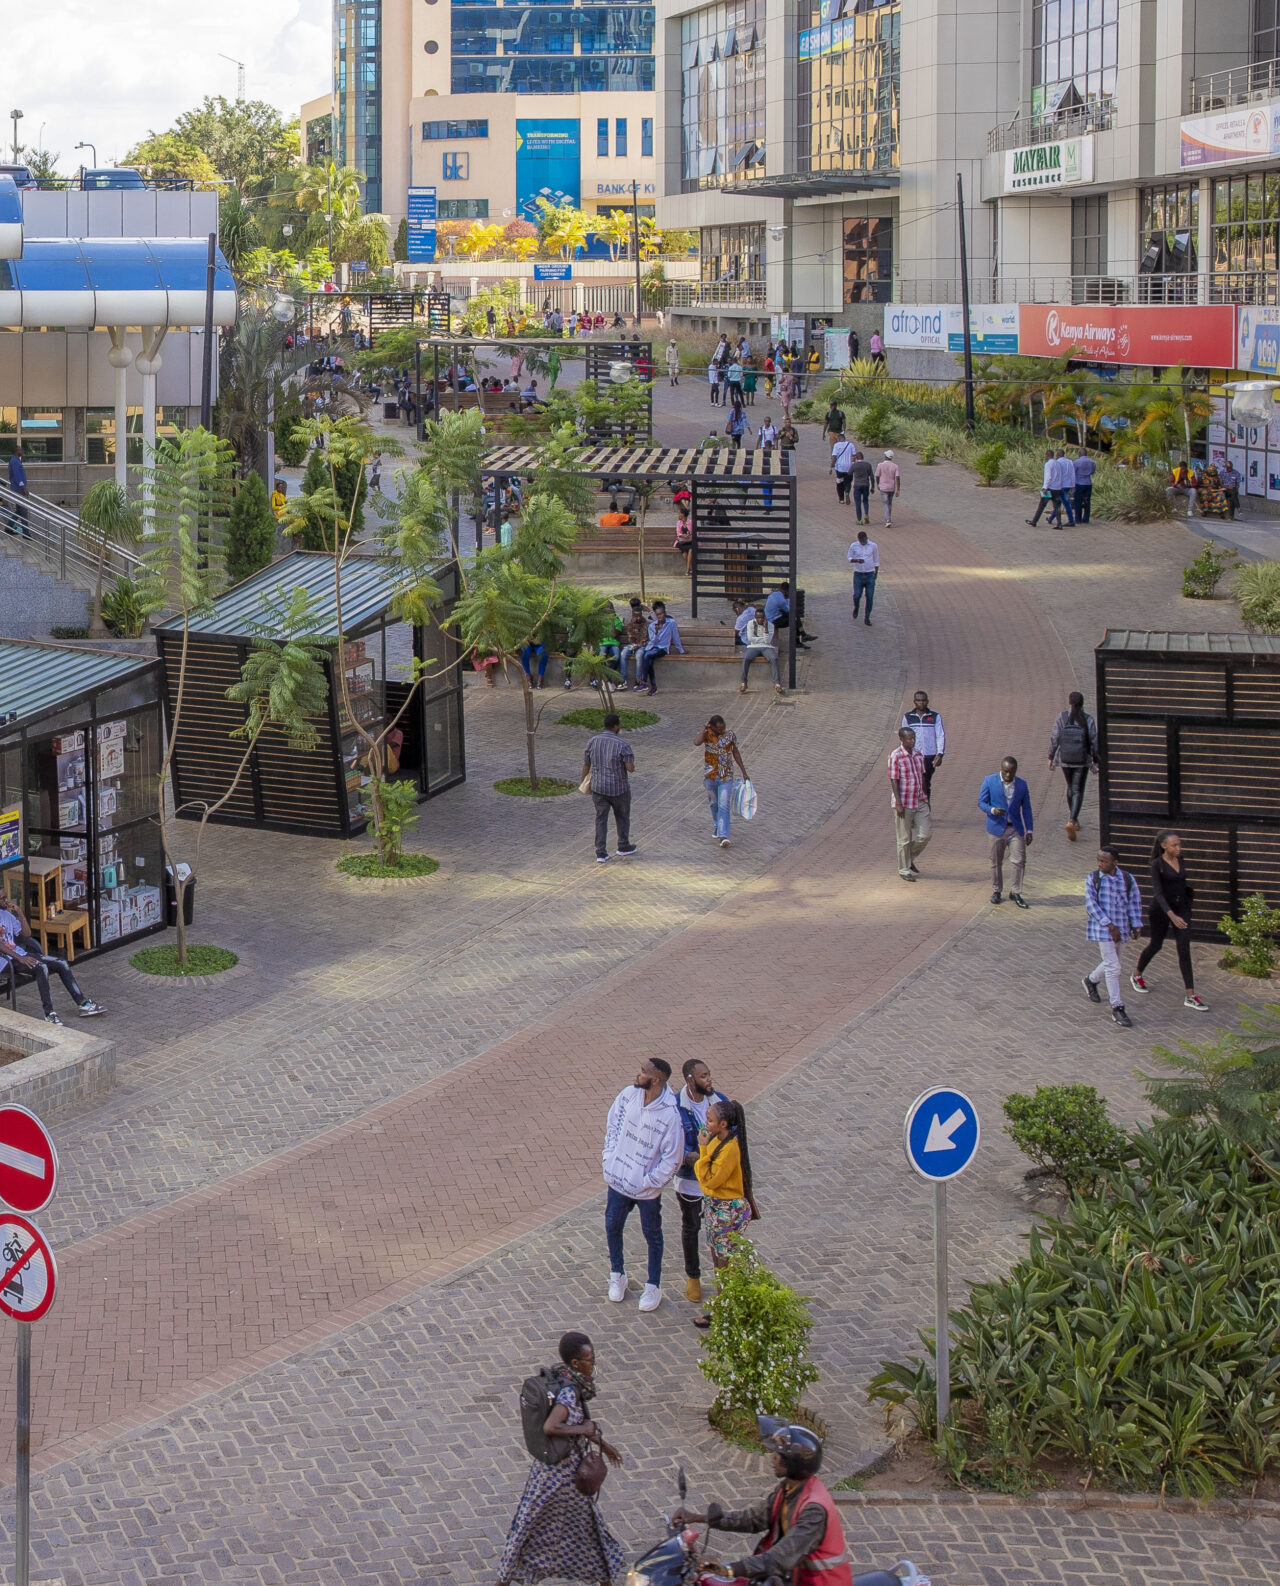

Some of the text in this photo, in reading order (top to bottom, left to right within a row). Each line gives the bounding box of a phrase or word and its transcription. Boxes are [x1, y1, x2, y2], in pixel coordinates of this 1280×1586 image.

[801, 24, 853, 49] FASHION SHOP
[1013, 145, 1061, 174] MAYFAIR
[597, 184, 625, 194] BANK
[627, 184, 641, 193] OF
[1012, 173, 1061, 188] INSURANCE
[921, 335, 940, 344] OPTICAL
[1061, 322, 1083, 342] Kenya
[1084, 323, 1116, 344] Airways
